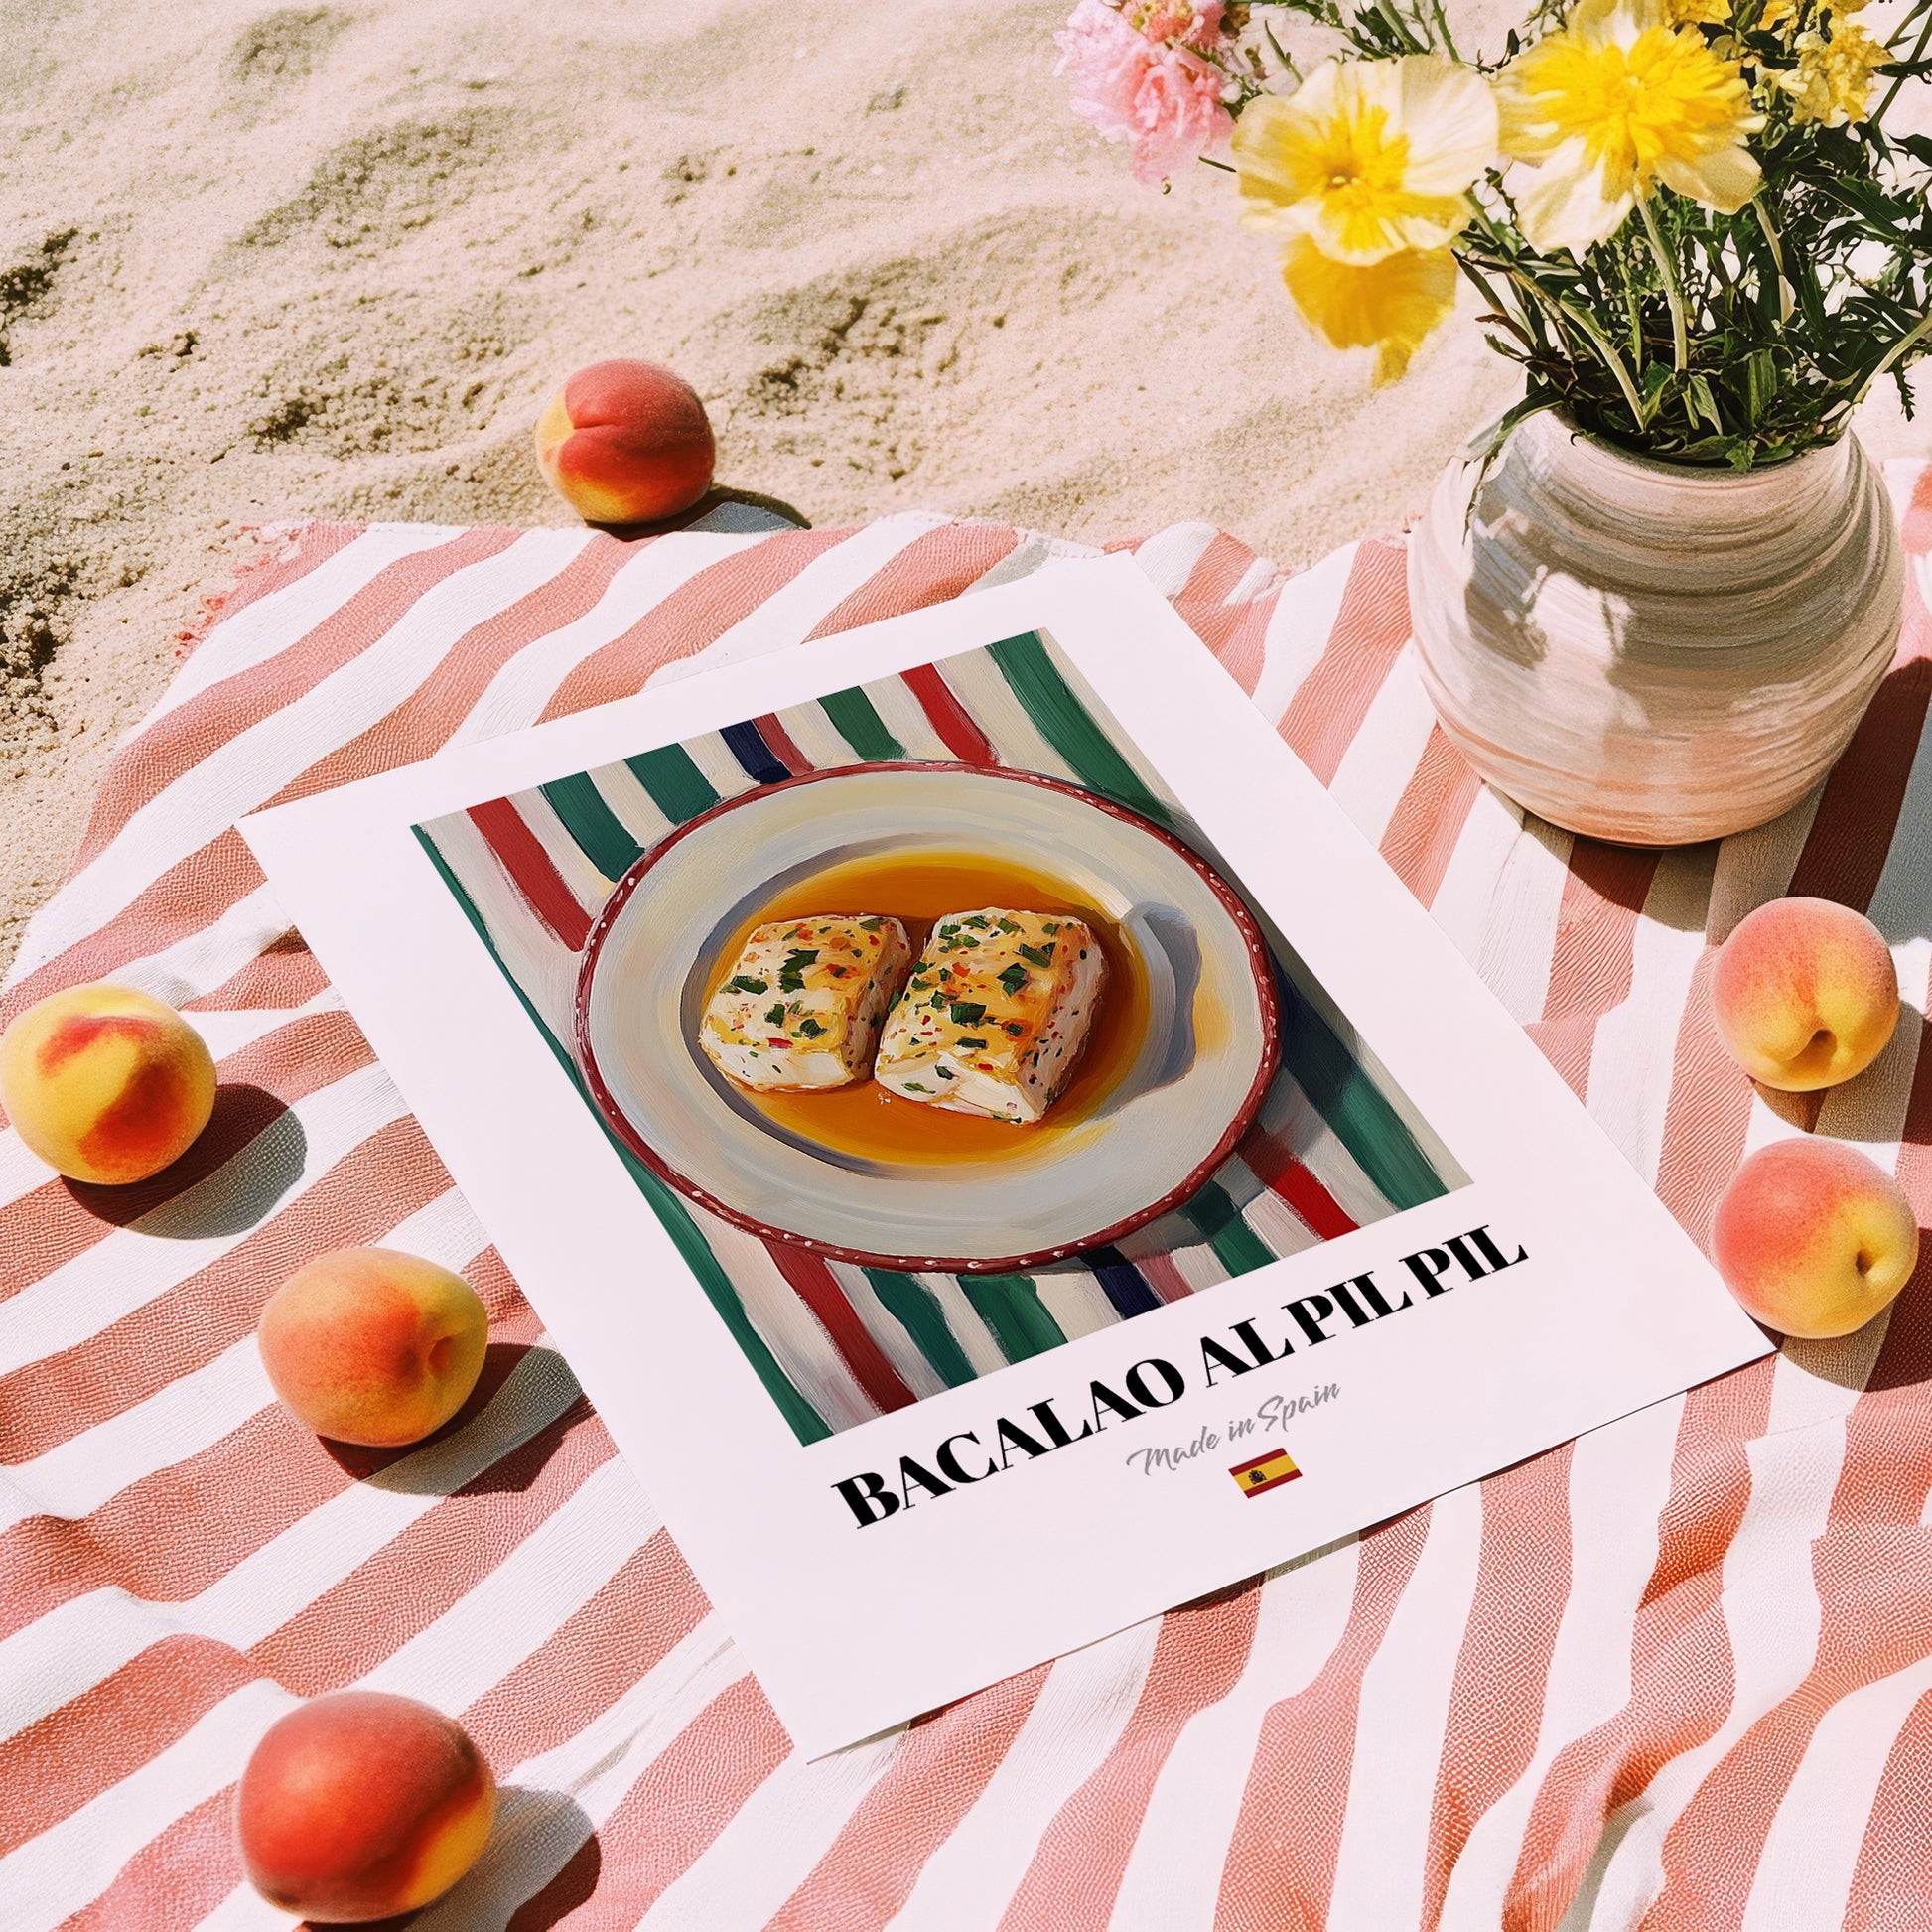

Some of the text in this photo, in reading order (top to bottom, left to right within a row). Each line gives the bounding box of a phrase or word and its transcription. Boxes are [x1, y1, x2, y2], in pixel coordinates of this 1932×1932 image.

[830, 1223, 1530, 1530] BACALAO AL PIL PIL
[1125, 1382, 1341, 1476] Made in Spain
